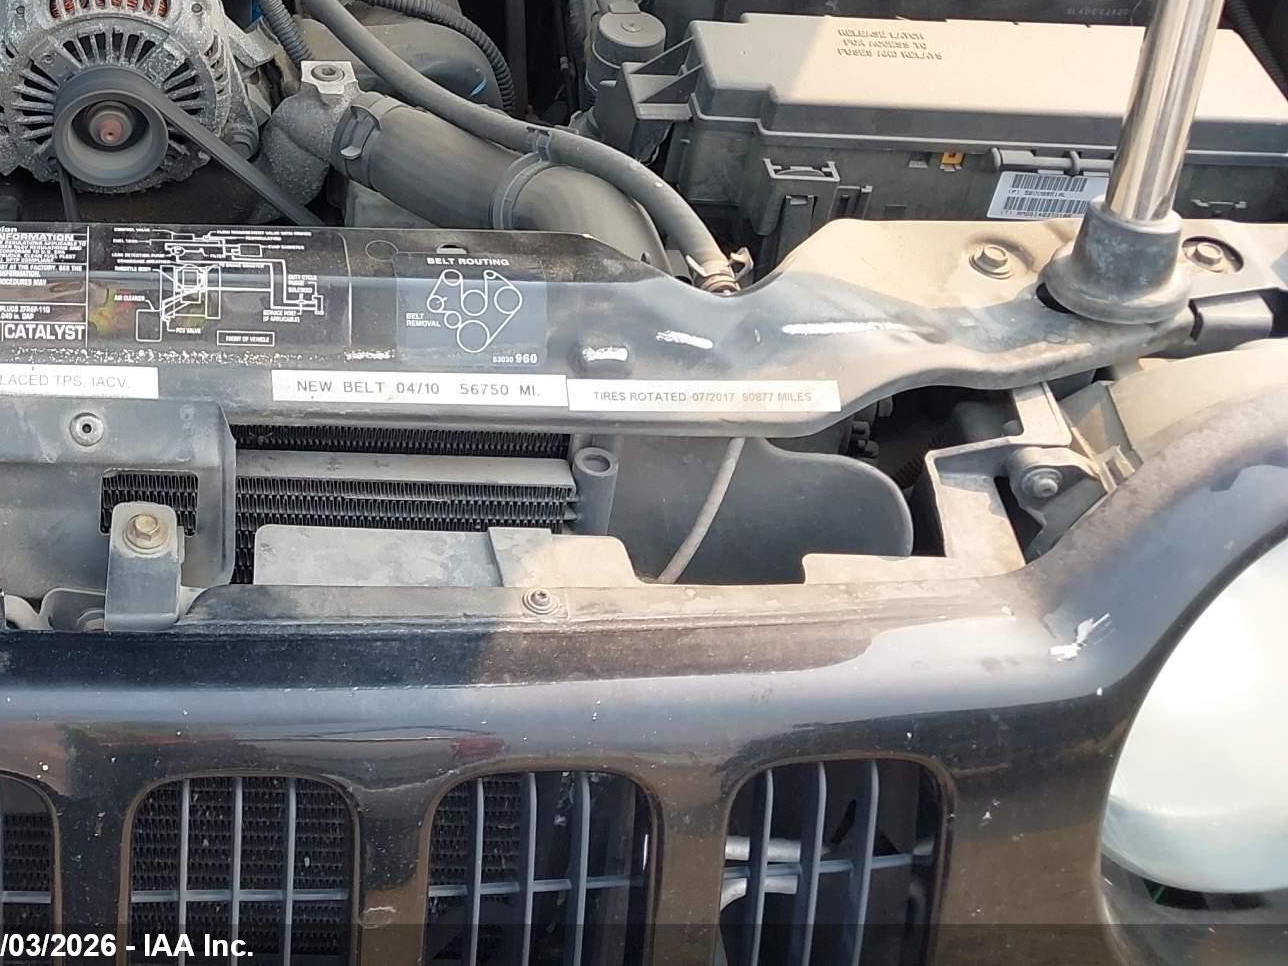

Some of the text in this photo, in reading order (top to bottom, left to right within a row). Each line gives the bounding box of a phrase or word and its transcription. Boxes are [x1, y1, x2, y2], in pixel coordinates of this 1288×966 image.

[426, 257, 510, 266] BELT ROUTING
[4, 324, 85, 340] CATALYST
[515, 353, 538, 364] 960
[296, 380, 541, 396] NEW BELT 04/10 56750 MI.
[593, 391, 626, 402] TIRES
[629, 391, 687, 402] ROTATED
[777, 393, 812, 403] MILES
